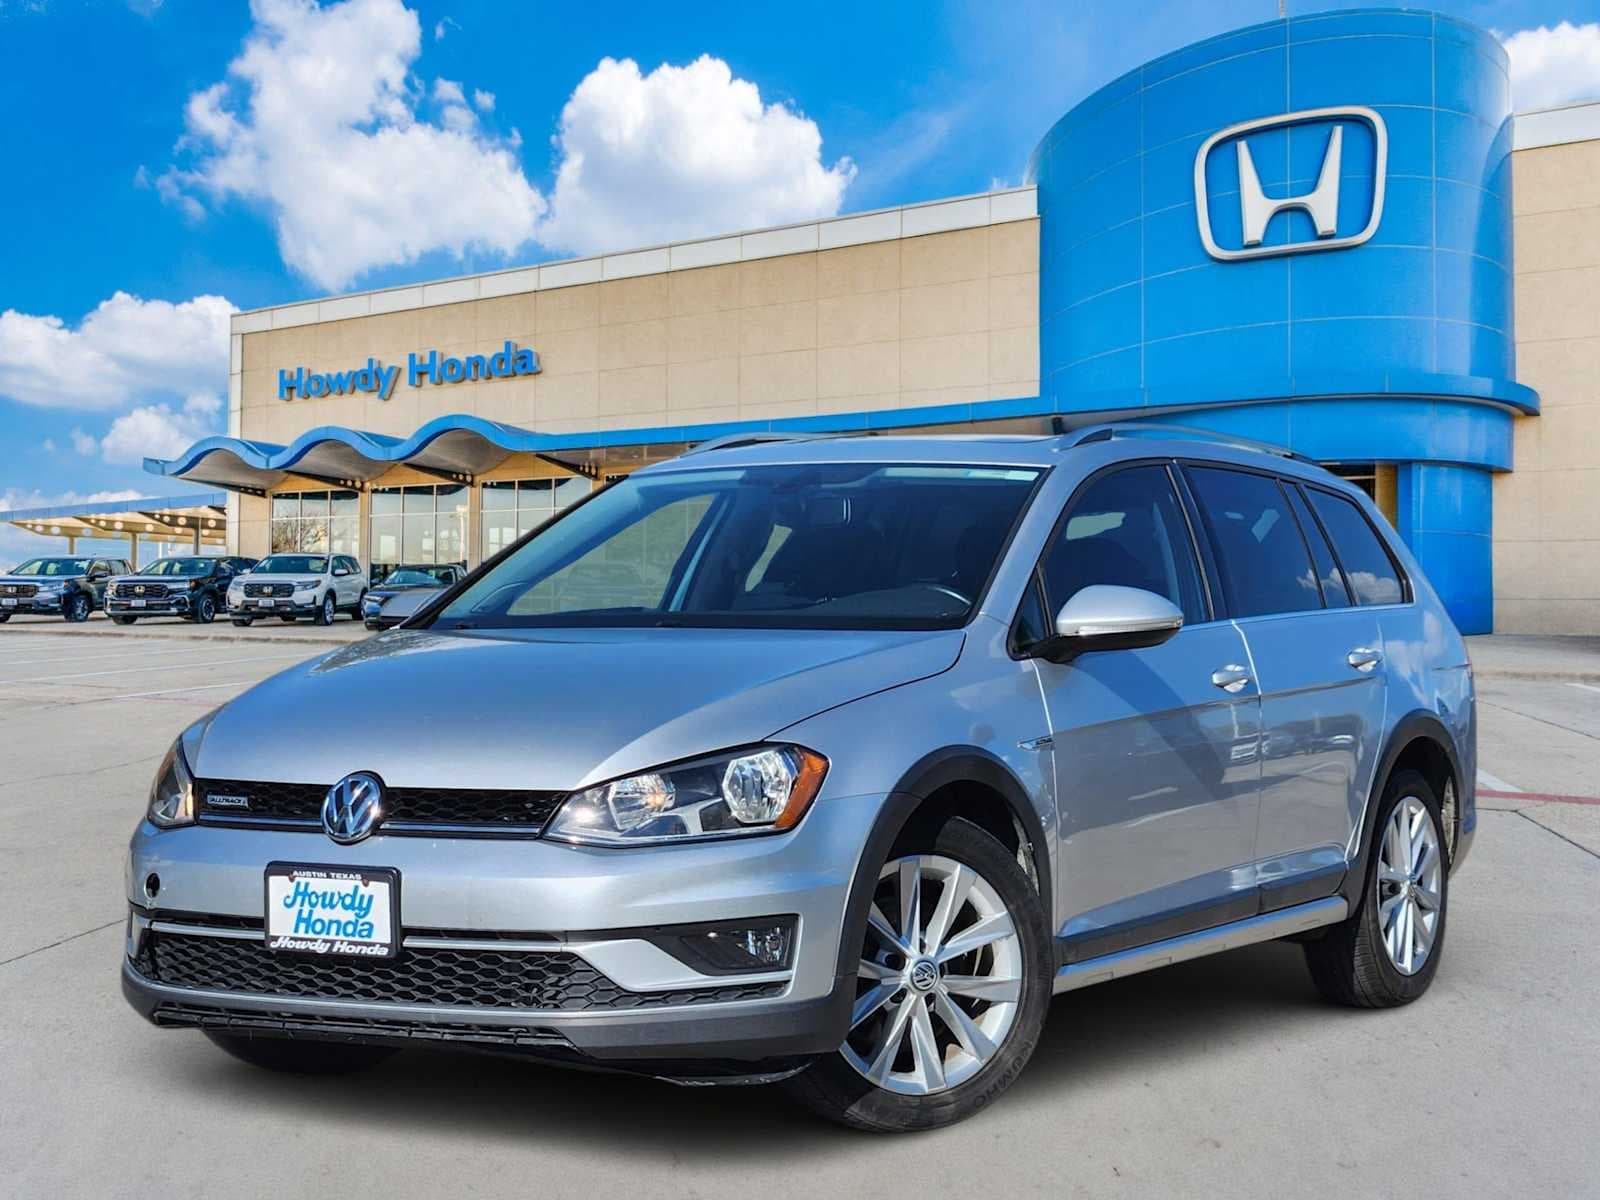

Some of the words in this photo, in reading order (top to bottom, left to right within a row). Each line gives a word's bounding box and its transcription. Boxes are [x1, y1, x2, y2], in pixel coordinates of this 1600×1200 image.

[278, 358, 402, 400] Howdy
[408, 340, 541, 387] Honda
[292, 870, 327, 879] AUSTIN
[329, 872, 362, 881] TEXAS
[283, 880, 374, 919] Howdy
[293, 908, 374, 939] Honda
[270, 936, 331, 953] Howdy
[332, 940, 389, 955] Honda
